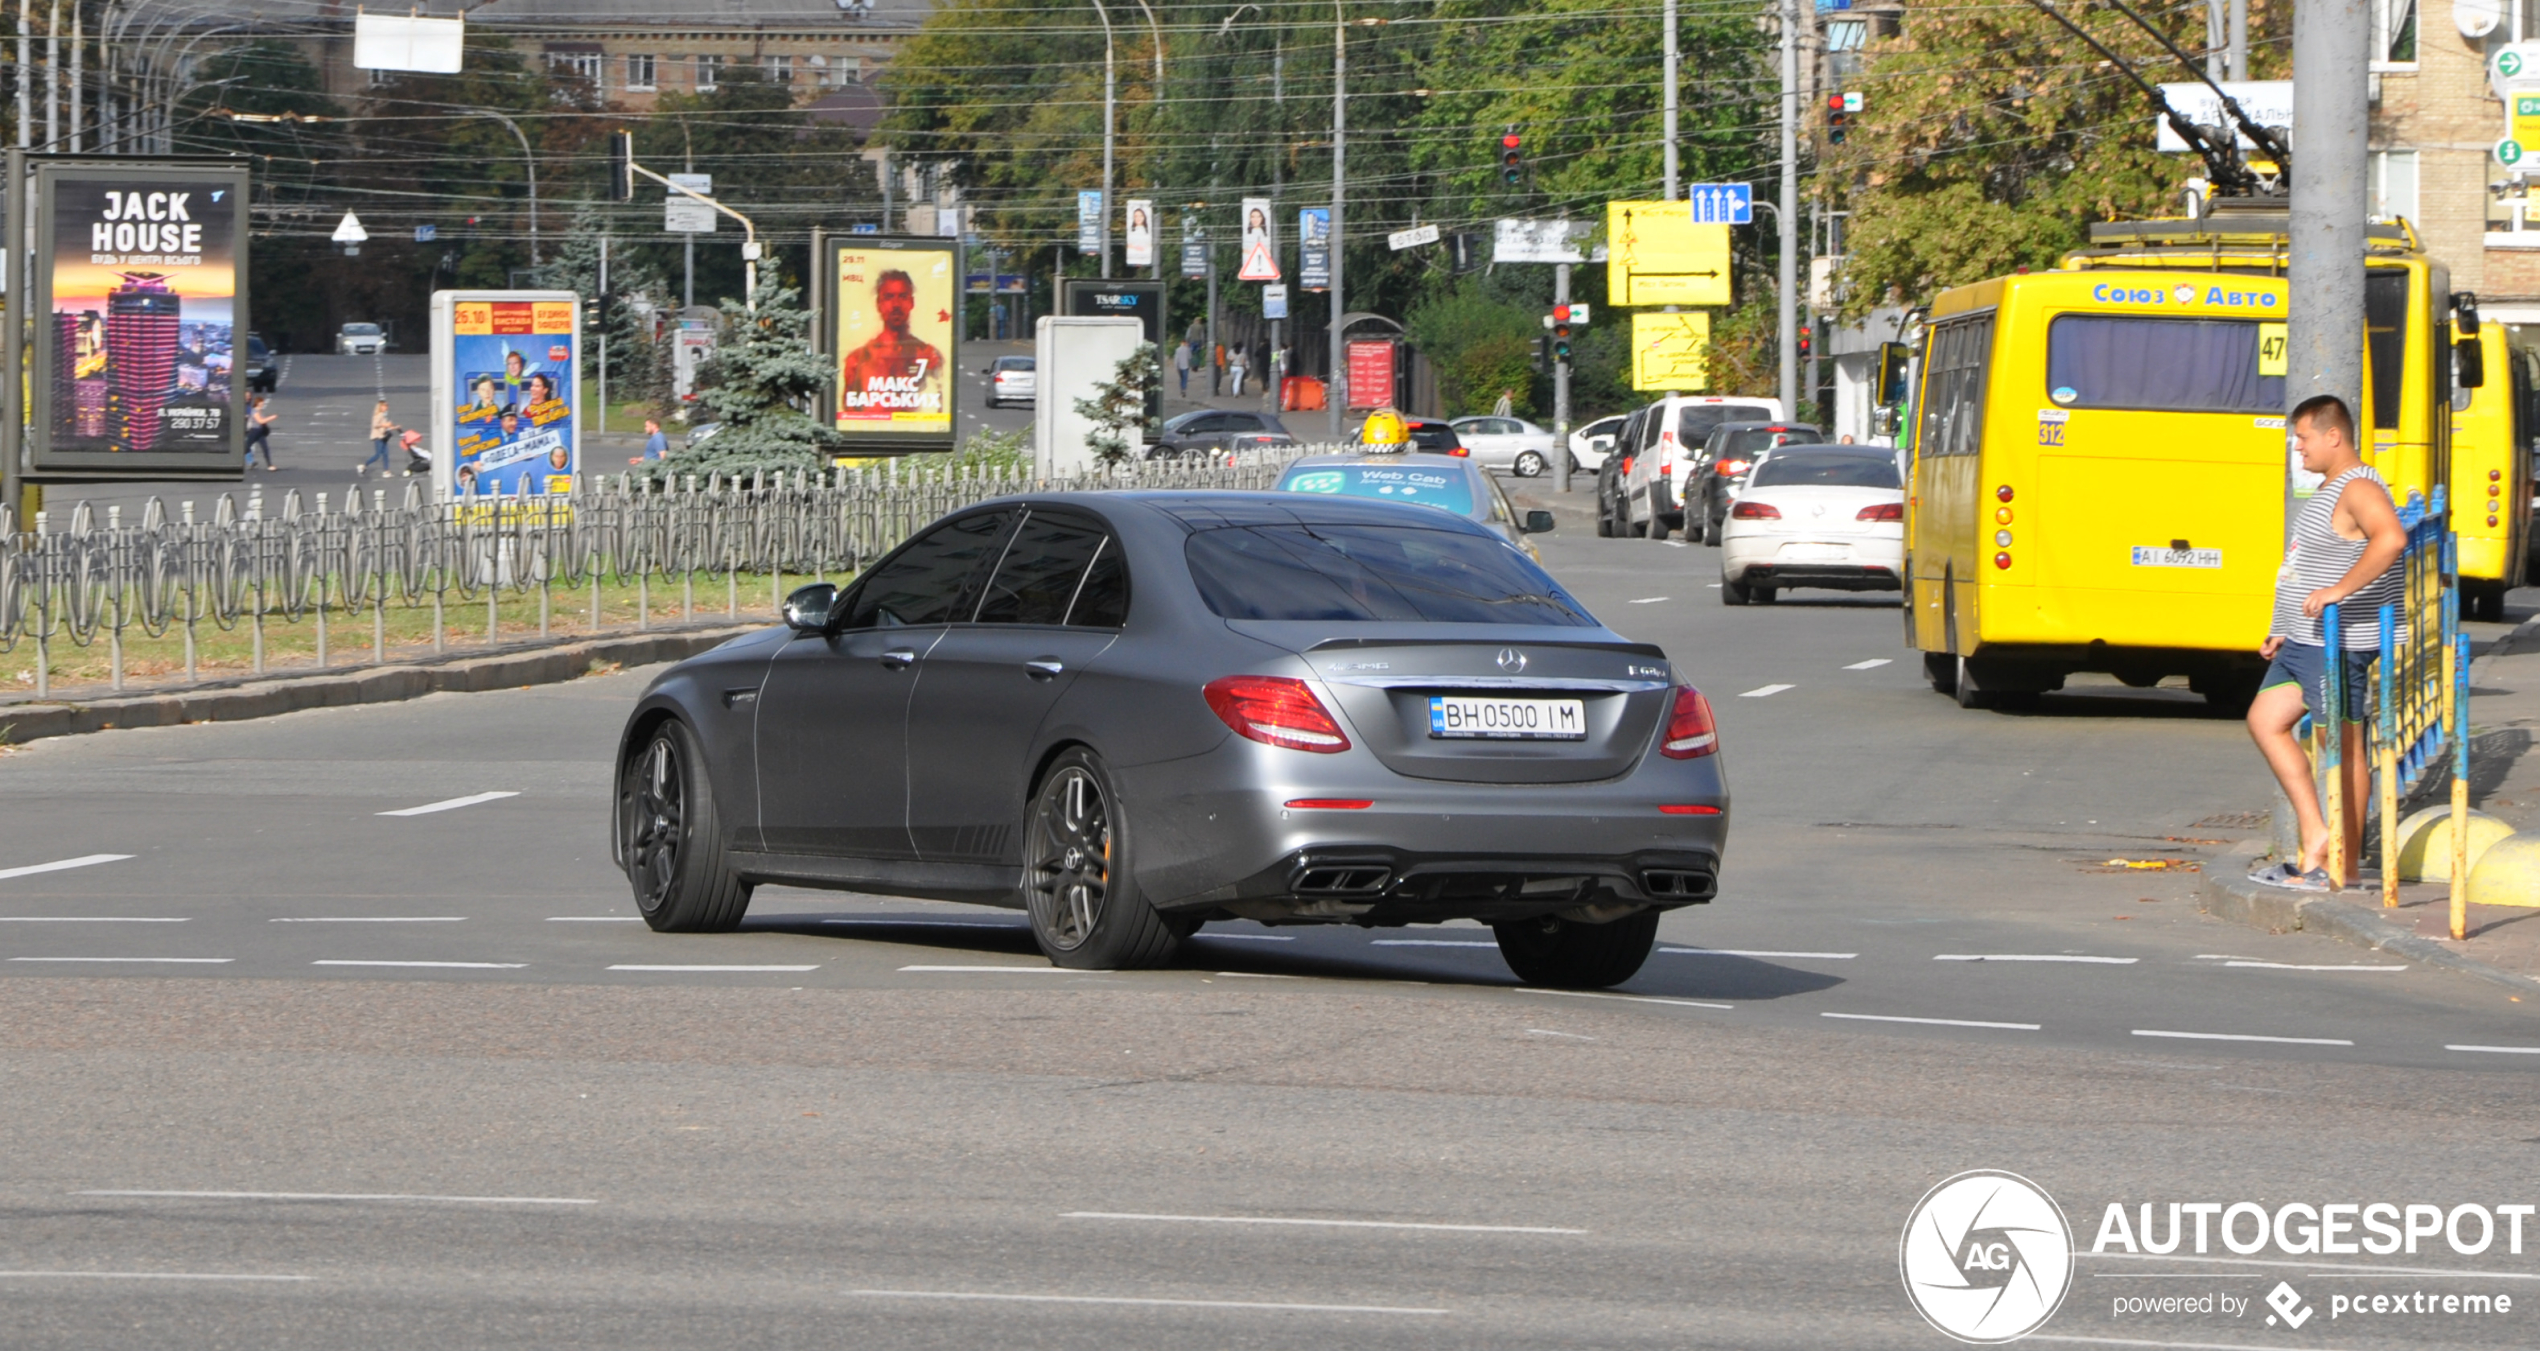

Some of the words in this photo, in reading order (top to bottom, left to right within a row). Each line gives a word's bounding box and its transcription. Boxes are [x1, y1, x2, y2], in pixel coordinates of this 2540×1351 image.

[103, 191, 190, 221] JACK
[92, 222, 202, 252] HOUSE
[91, 254, 118, 265] БУДЬ
[119, 255, 127, 264] У
[128, 255, 162, 265] ЦЕНТРІ
[164, 255, 201, 265] ВСЬОГО
[2093, 283, 2165, 304] Союз
[2204, 286, 2277, 307] Авто
[455, 310, 485, 324] 26.10
[867, 376, 920, 392] МАКС
[846, 391, 941, 408] БАРСЬКИХ
[170, 418, 192, 429] 290
[192, 418, 206, 429] 37
[206, 418, 221, 429] 57
[2040, 423, 2064, 444] 312
[1362, 470, 1404, 480] Web
[1408, 472, 1447, 484] Cab
[1432, 718, 1444, 728] UA
[1484, 704, 1538, 728] 0500
